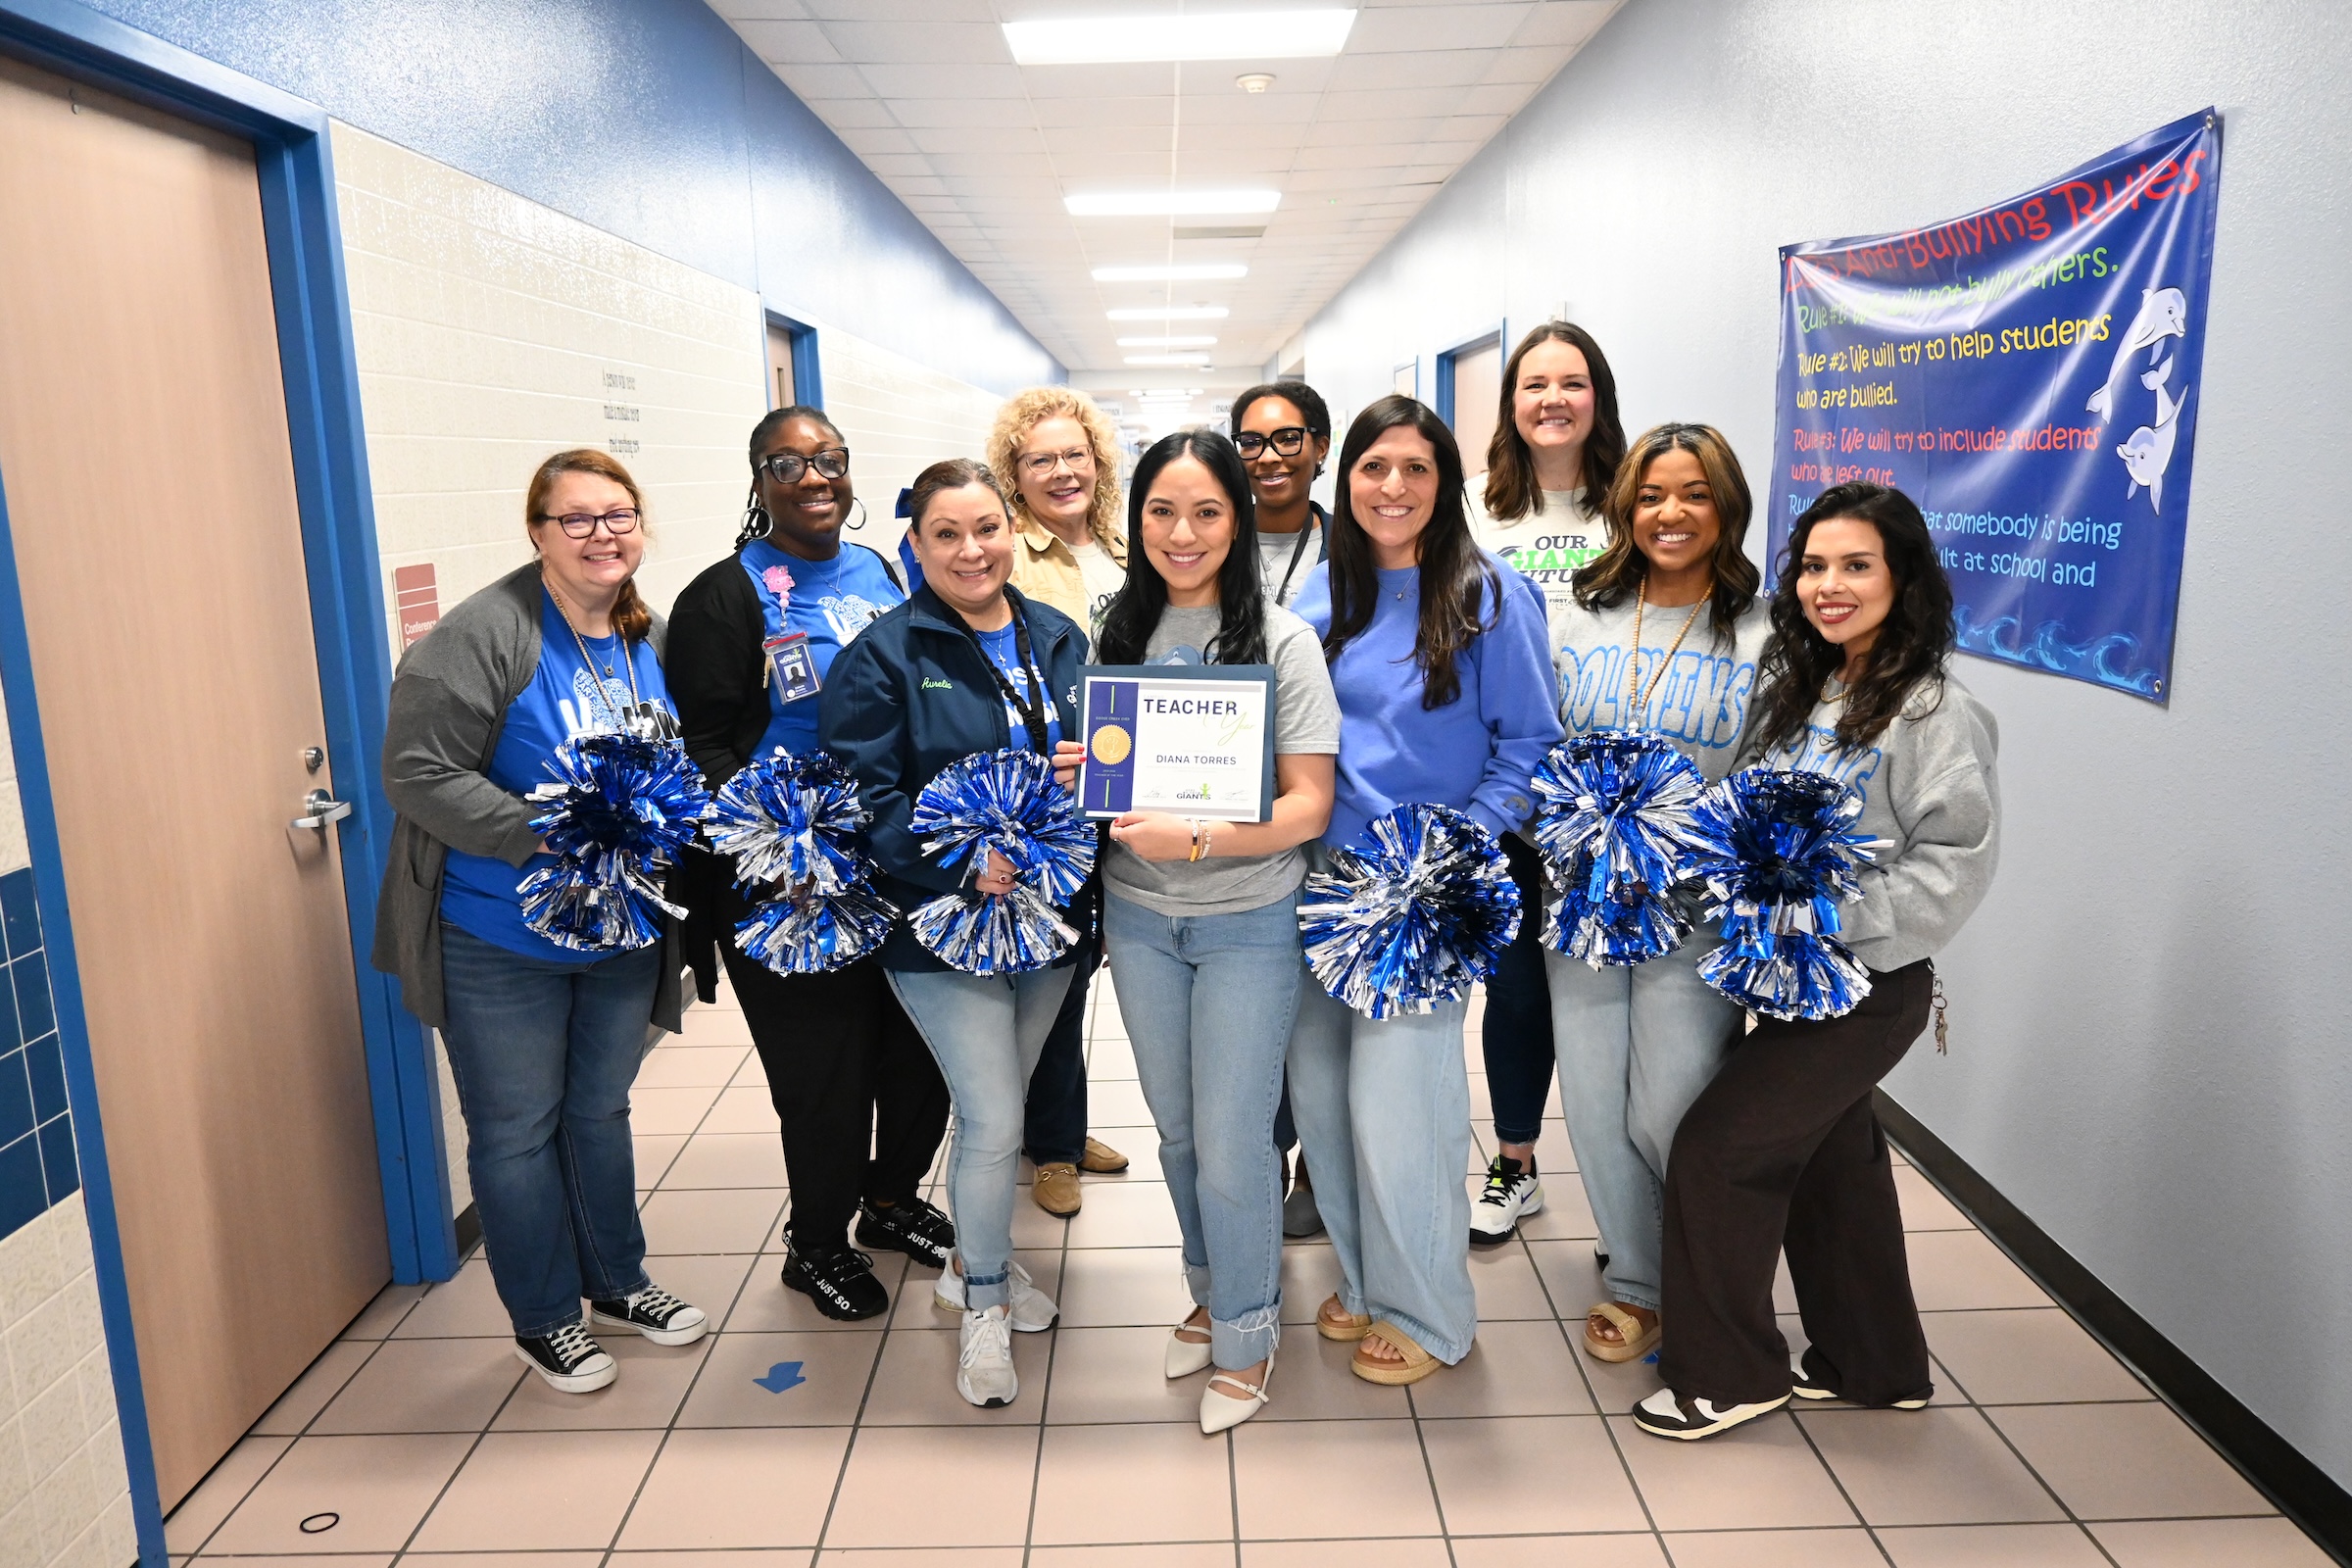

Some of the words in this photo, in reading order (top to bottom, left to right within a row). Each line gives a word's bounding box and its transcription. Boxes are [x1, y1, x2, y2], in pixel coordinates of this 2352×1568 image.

[1845, 197, 2052, 278] Anti-Bullying
[2049, 149, 2206, 230] Rules
[1797, 305, 1829, 334] Rule
[1963, 268, 2018, 307] bully
[2017, 246, 2119, 291] others.
[1797, 352, 1827, 377] Rule
[1829, 350, 1848, 372] #2:
[1849, 344, 1870, 373] We
[1871, 341, 1895, 368] will
[1898, 340, 1922, 366] try
[1925, 337, 1945, 362] to
[1949, 330, 1994, 361] help
[1999, 313, 2113, 355] students
[1796, 387, 1818, 411] who
[1820, 388, 1847, 410] are
[1849, 380, 1898, 409] bullied.
[1793, 428, 1819, 453] Rule
[1840, 426, 1865, 454] We
[1867, 427, 1891, 453] will
[1893, 429, 1914, 454] try
[1917, 430, 1936, 452] to
[1938, 425, 2006, 454] include
[2008, 422, 2102, 454] students
[1790, 462, 1818, 482] who
[1835, 464, 1863, 485] left
[1865, 467, 1896, 487] out.
[1535, 535, 1589, 551] OUR
[1944, 511, 2038, 541] somebody
[2041, 514, 2056, 541] is
[2058, 515, 2123, 550] being
[1964, 551, 1985, 572] at
[1990, 552, 2047, 583] school
[2052, 561, 2096, 588] and
[1144, 699, 1238, 715] TEACHER
[1560, 644, 1756, 750] DOLPHINS
[1156, 755, 1190, 764] DIANA
[1194, 756, 1237, 765] TORRES
[907, 1231, 934, 1250] JUST
[815, 1278, 839, 1298] JUST
[834, 1295, 851, 1311] SO
